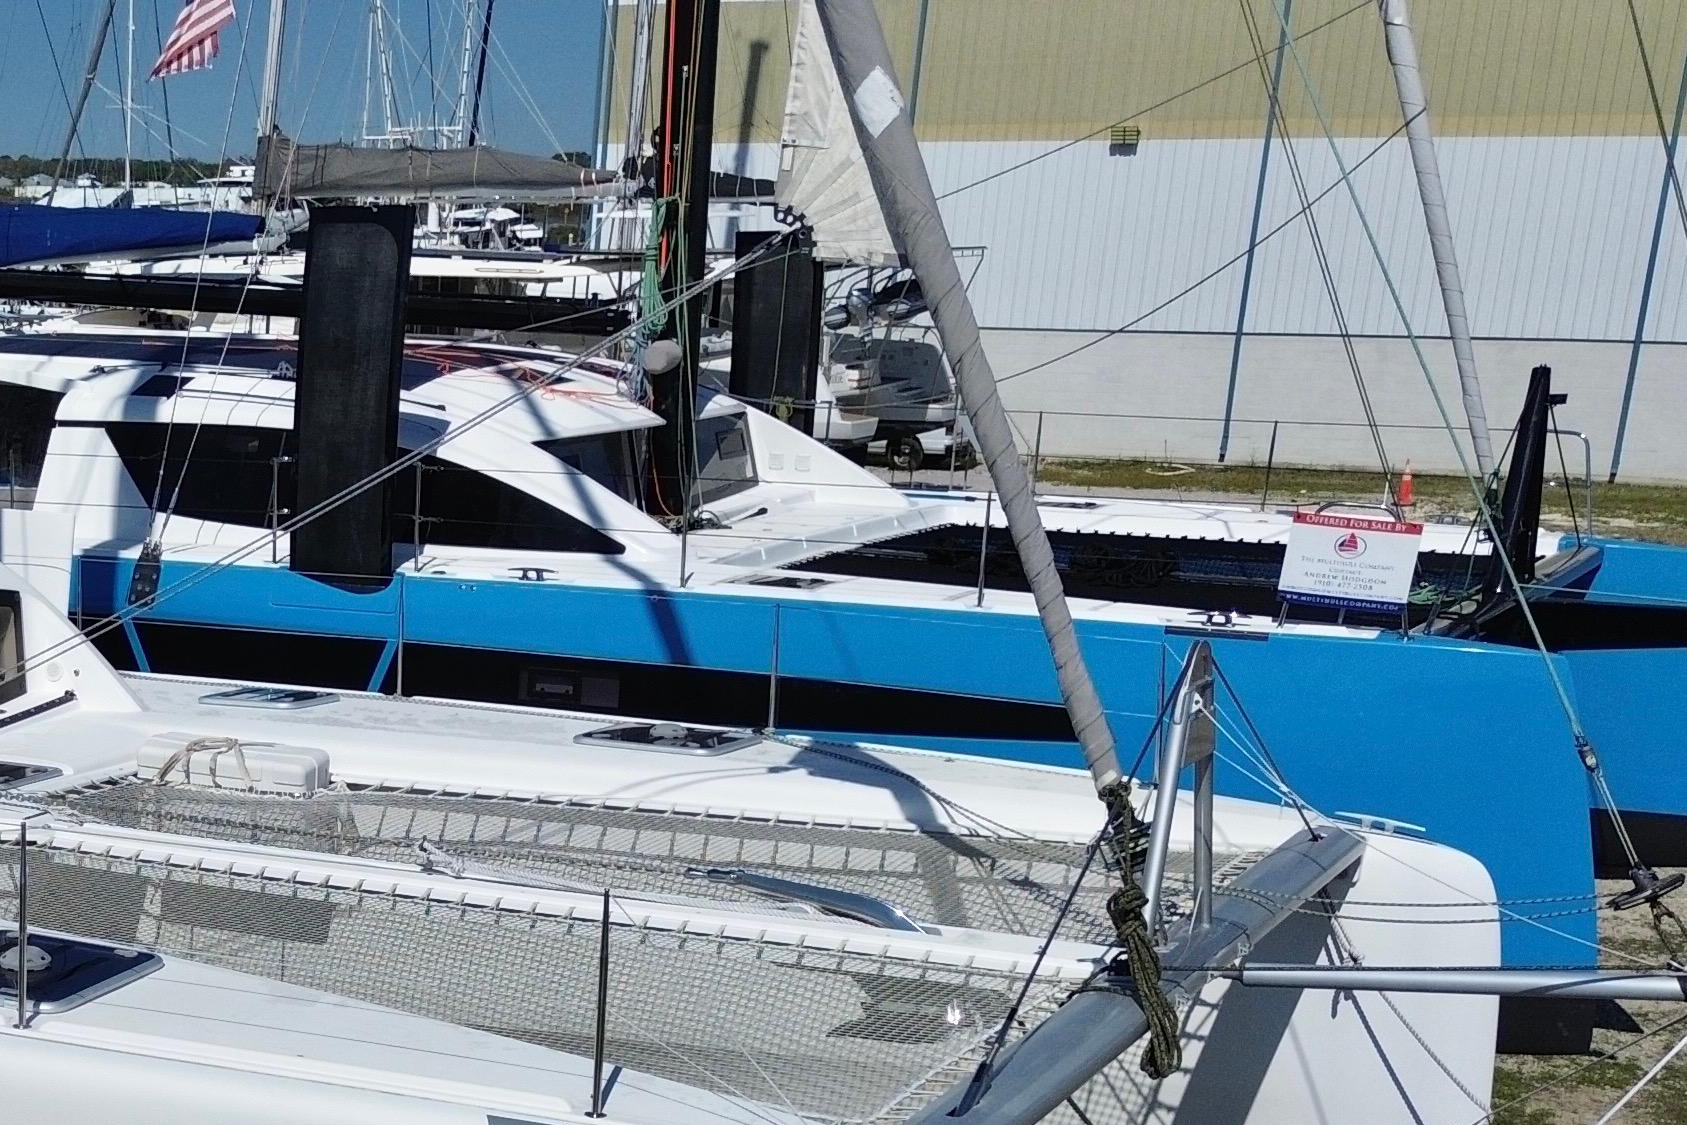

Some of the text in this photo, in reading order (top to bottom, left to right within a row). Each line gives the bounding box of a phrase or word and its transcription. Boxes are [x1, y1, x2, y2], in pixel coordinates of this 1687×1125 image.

[1306, 515, 1407, 532] OFFERED FOR SALE BY
